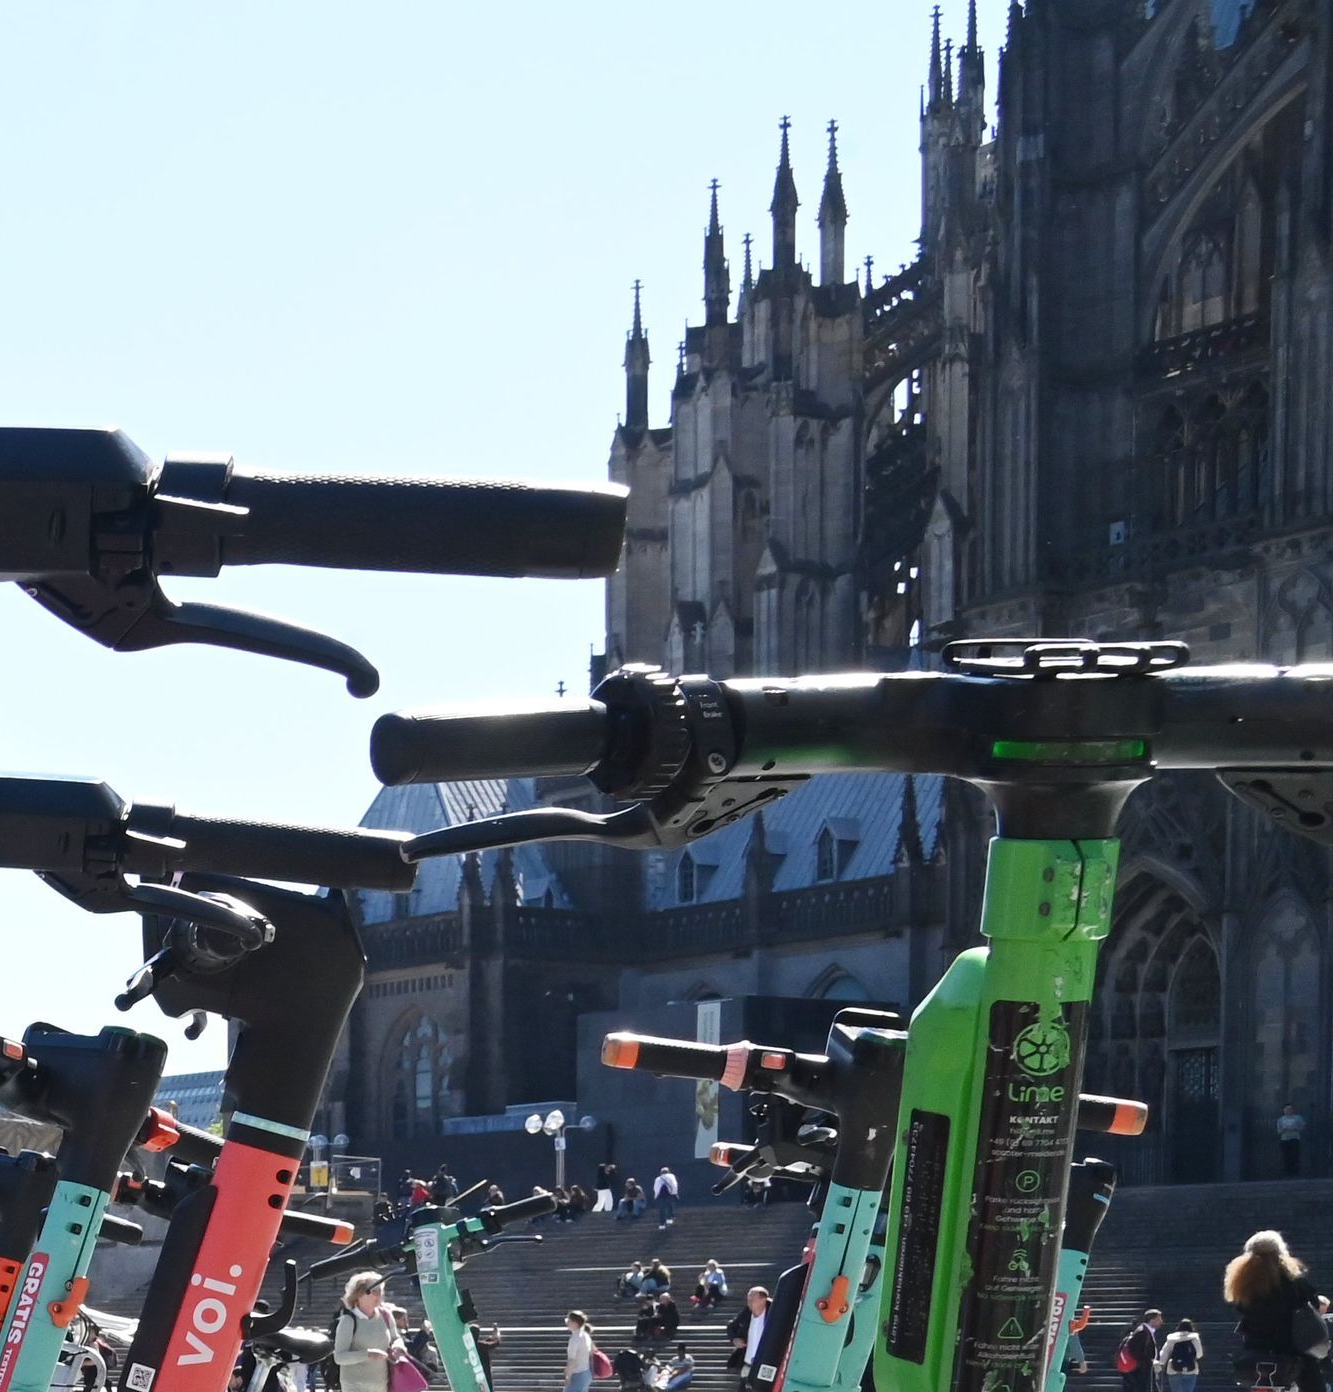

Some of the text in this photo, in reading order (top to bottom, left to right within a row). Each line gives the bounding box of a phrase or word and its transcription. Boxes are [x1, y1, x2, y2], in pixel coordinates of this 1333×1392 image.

[1008, 1083, 1065, 1102] Lime
[7, 1262, 44, 1345] GRATIS
[177, 1264, 243, 1367] voi.
